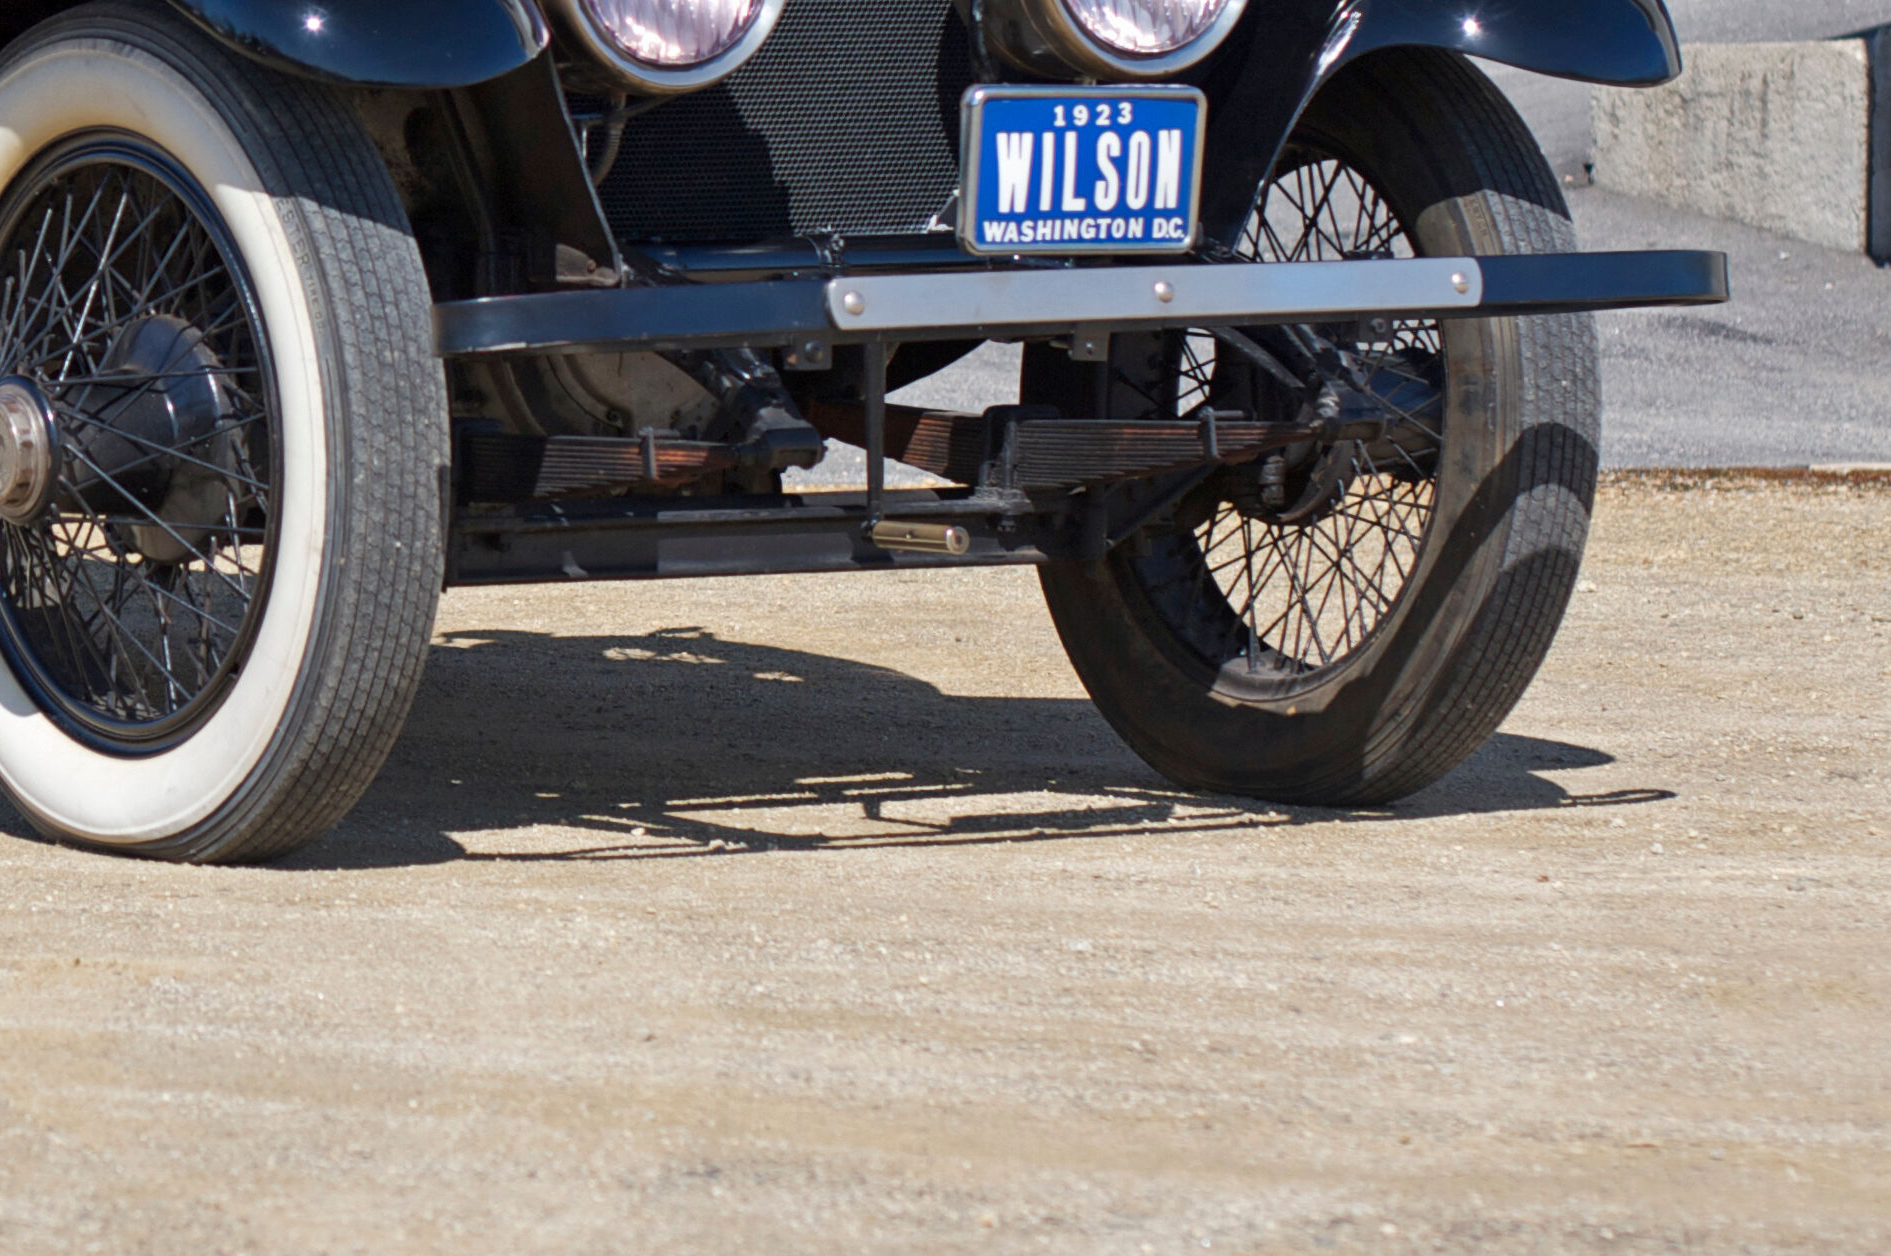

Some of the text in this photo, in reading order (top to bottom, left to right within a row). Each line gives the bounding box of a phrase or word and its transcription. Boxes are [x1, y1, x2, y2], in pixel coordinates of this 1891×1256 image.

[1053, 102, 1133, 127] 1923
[996, 129, 1182, 214] WILSON
[983, 217, 1185, 243] WASHINGTON D.C.
